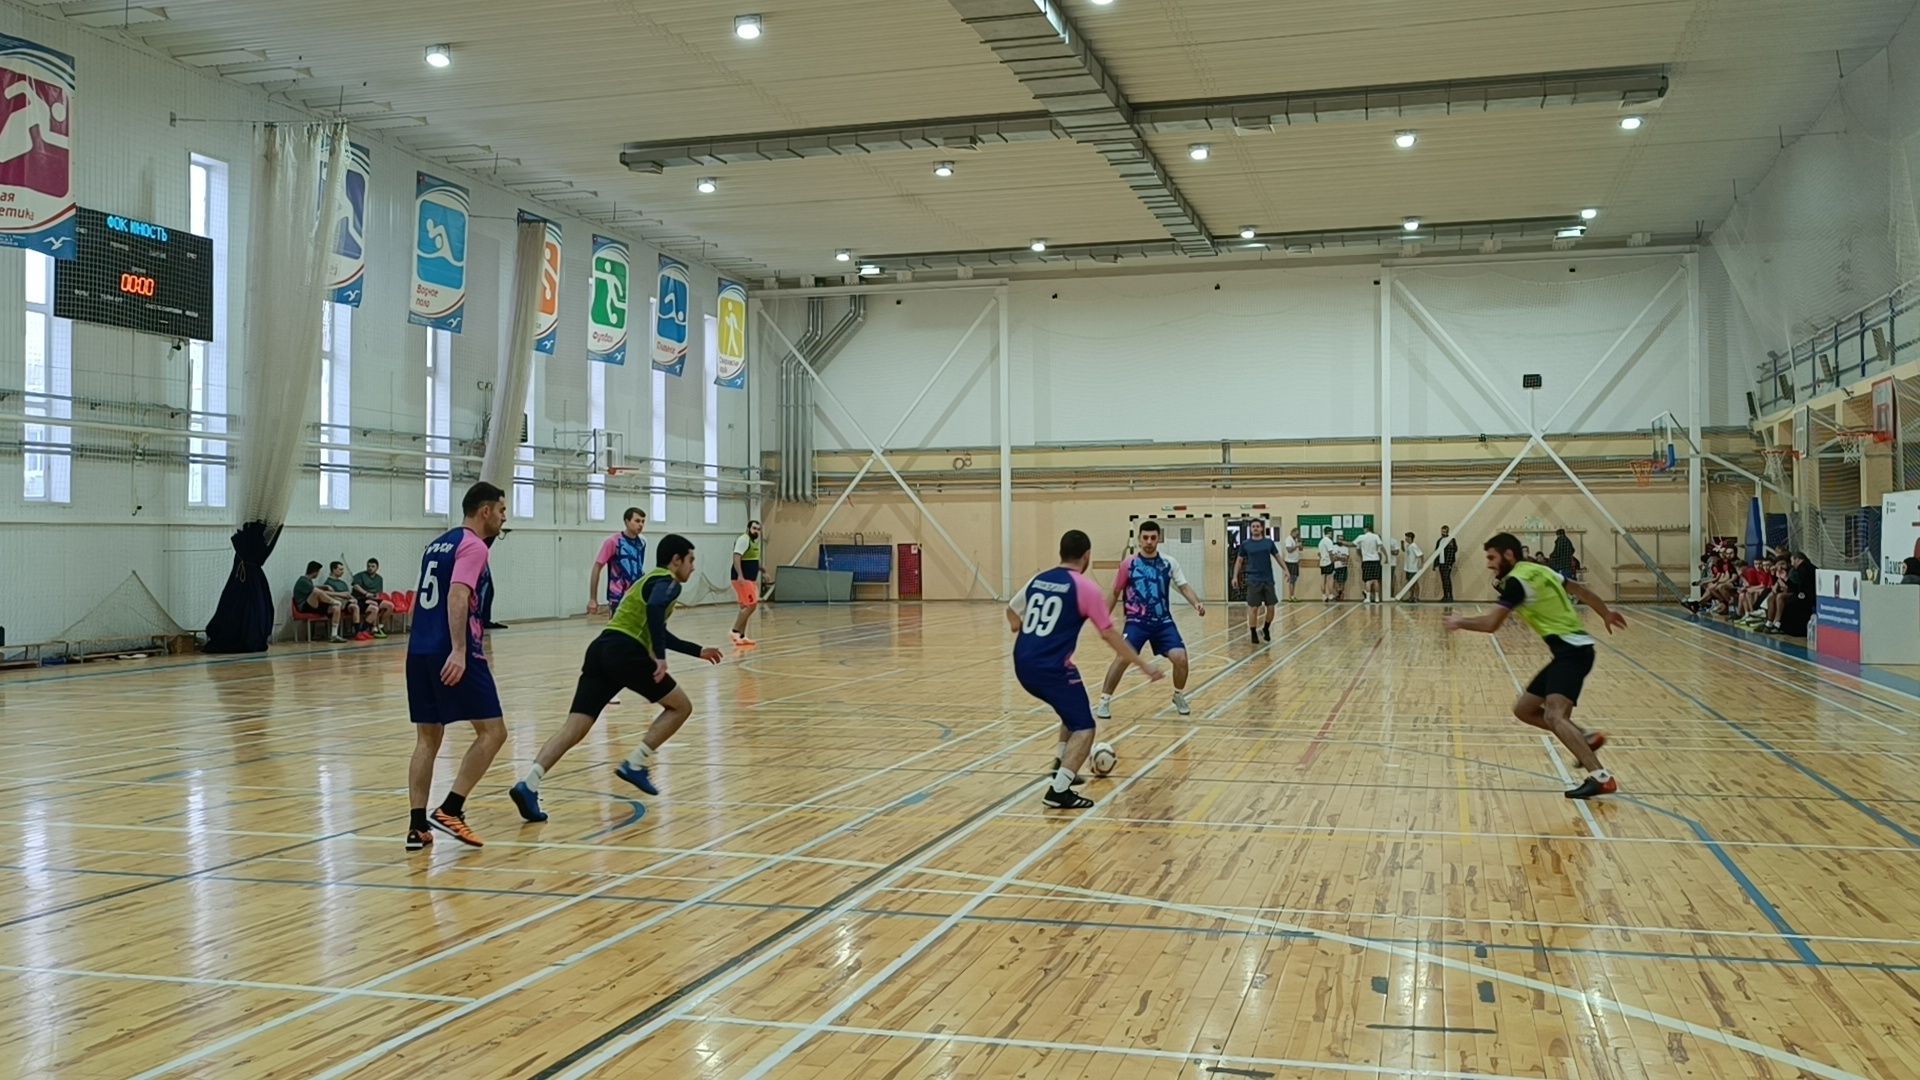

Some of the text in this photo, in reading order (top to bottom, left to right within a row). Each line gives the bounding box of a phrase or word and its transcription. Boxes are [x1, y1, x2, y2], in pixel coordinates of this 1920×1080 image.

[107, 215, 129, 233] ФОК
[121, 273, 155, 296] 00:00
[420, 560, 439, 610] 5
[1022, 592, 1063, 637] 69
